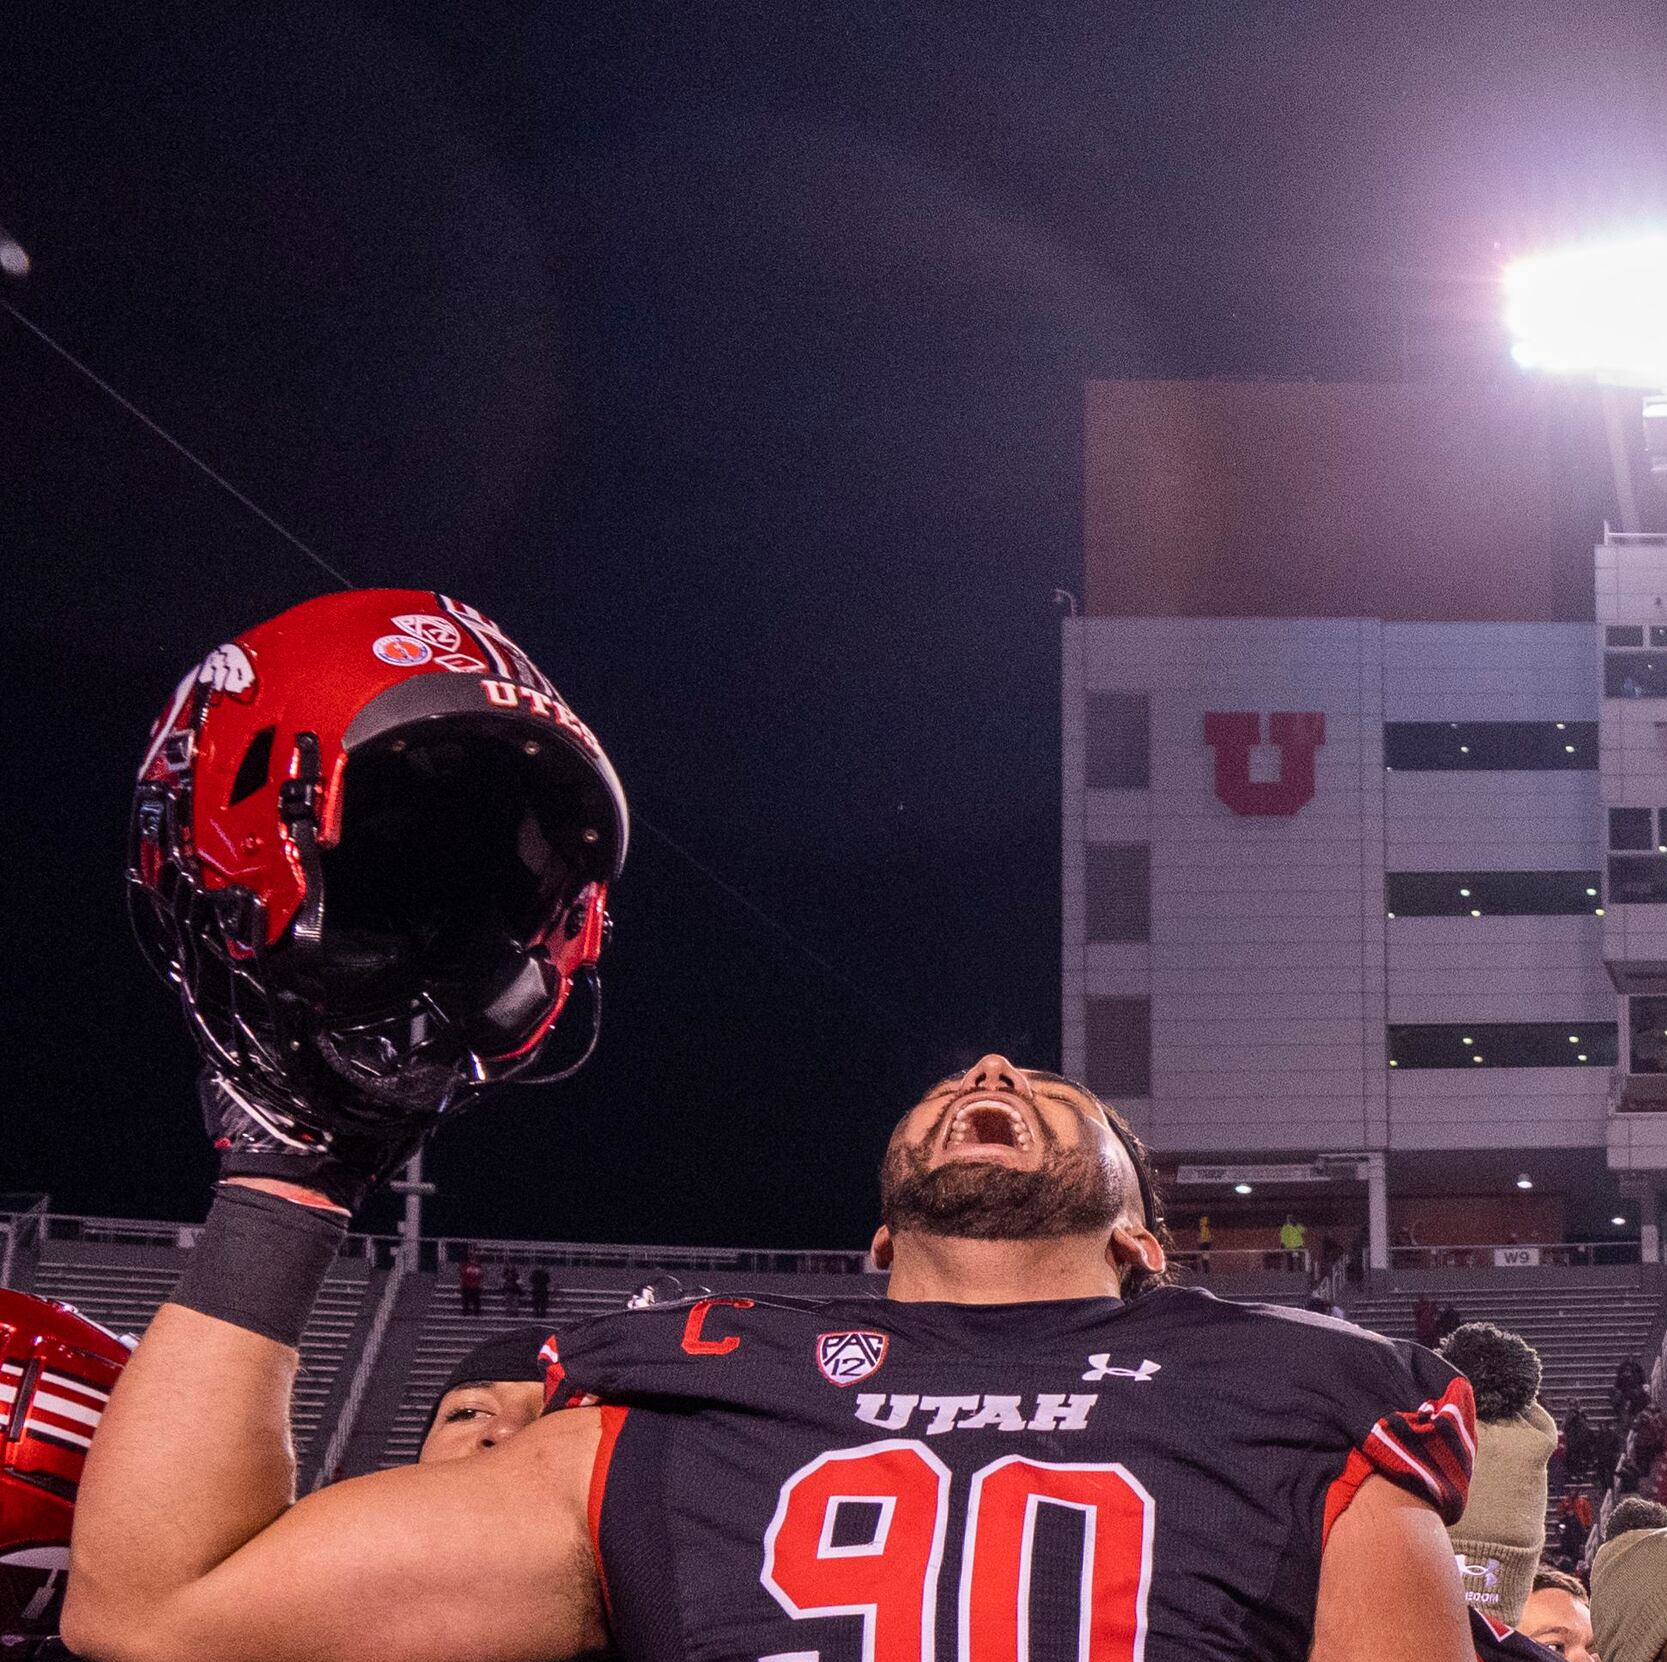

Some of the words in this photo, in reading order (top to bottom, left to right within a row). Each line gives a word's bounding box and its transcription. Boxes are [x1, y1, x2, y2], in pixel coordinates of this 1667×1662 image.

[1204, 711, 1325, 817] U
[1503, 1250, 1530, 1264] W9
[681, 1299, 756, 1355] C
[821, 1332, 884, 1366] PAC
[831, 1357, 866, 1377] 12
[854, 1392, 1099, 1436] UTAH
